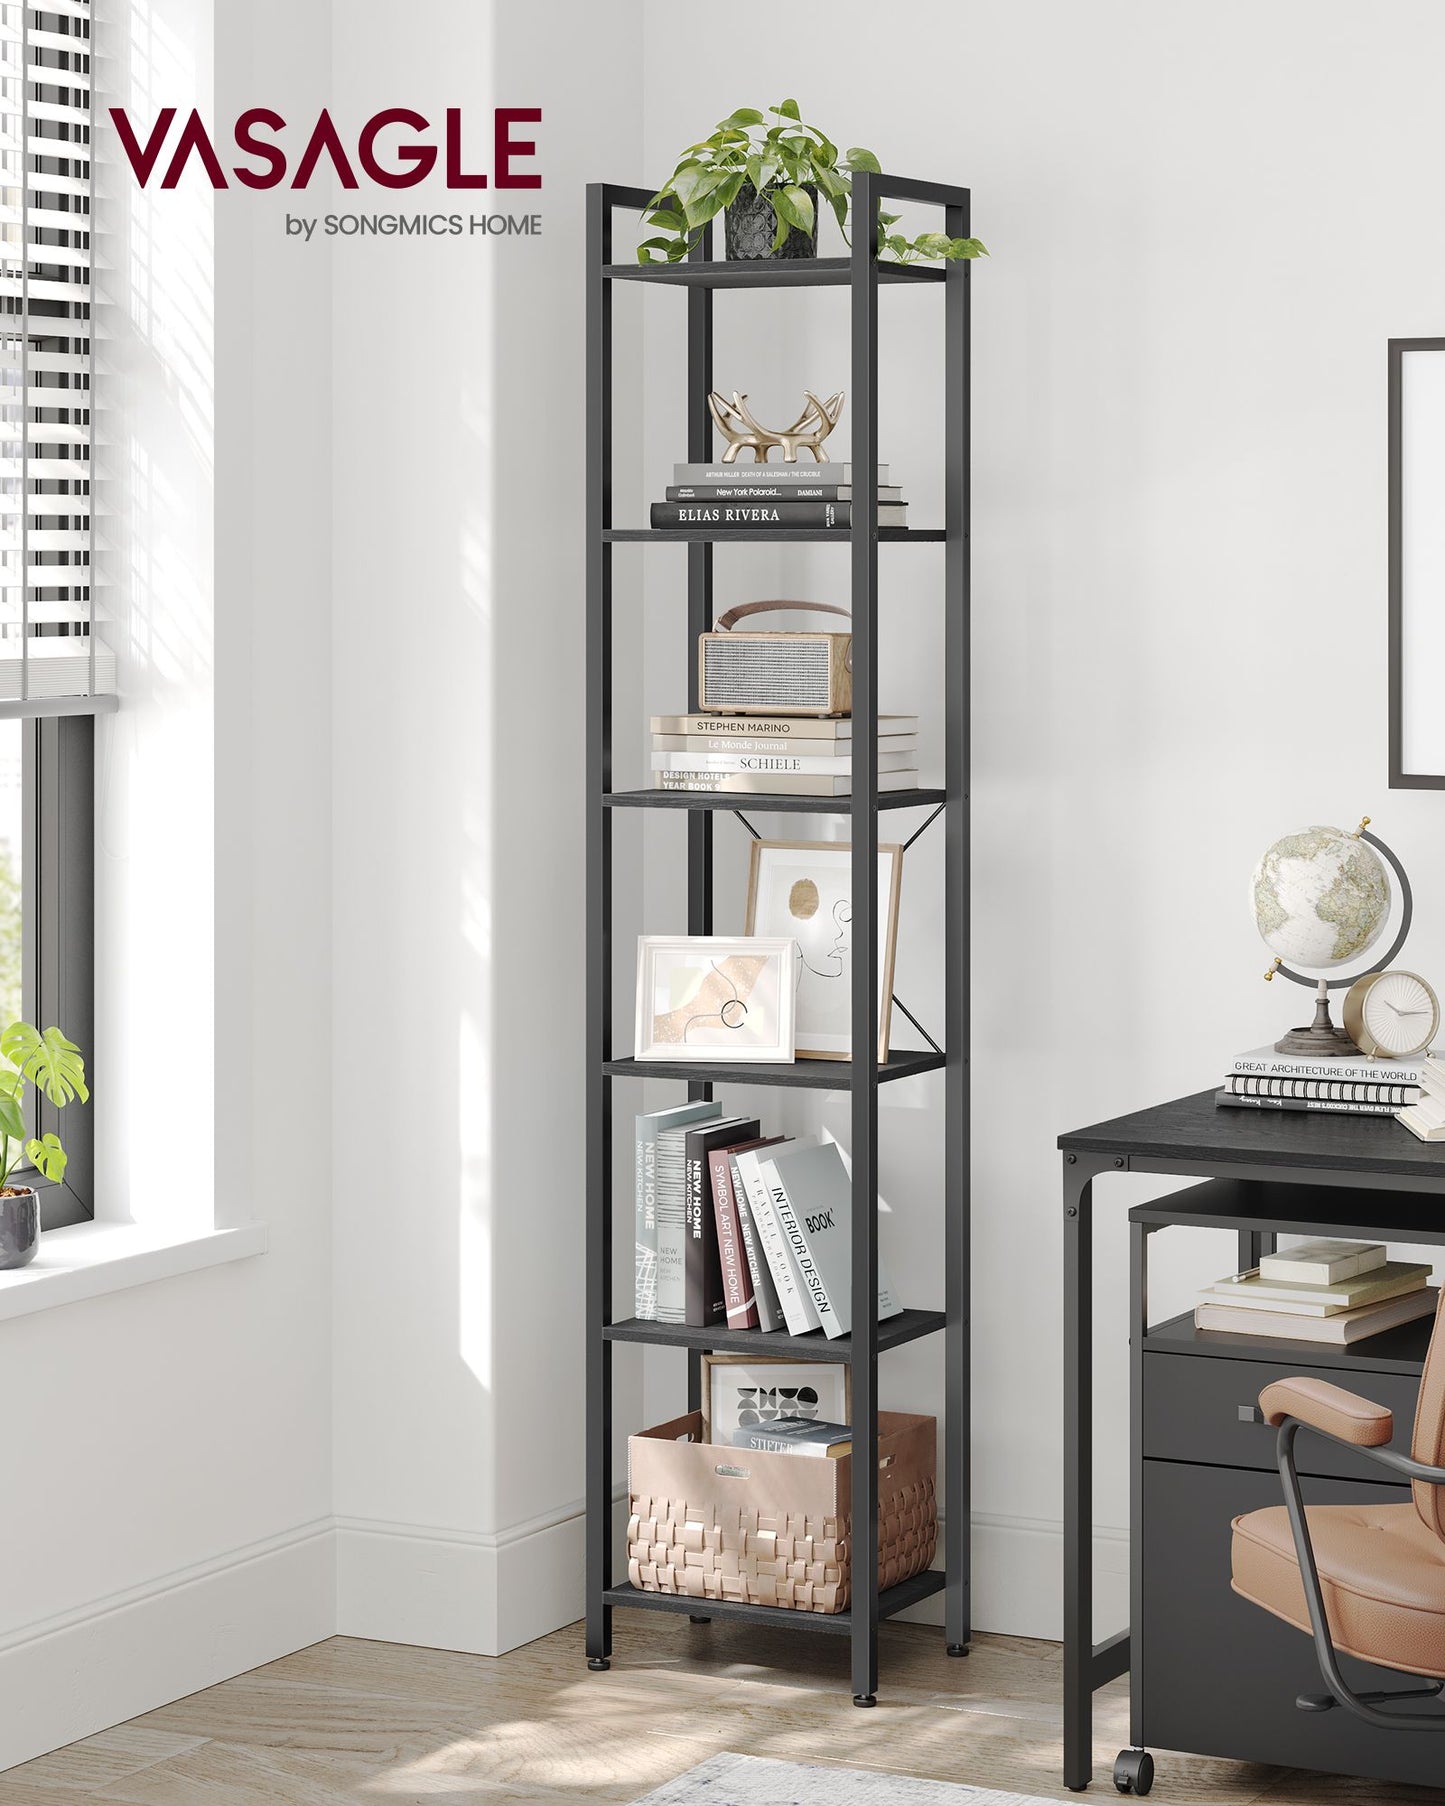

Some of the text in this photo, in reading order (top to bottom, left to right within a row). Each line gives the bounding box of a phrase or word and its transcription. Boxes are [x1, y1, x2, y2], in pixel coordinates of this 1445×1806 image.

[716, 488, 732, 496] New
[733, 488, 748, 496] York
[678, 509, 781, 521] ELIAS RIVERA
[697, 721, 790, 733] STEPHEN MARINO
[708, 740, 787, 751] Le Monde Journal
[740, 757, 801, 771] SCHIELE
[663, 771, 730, 781] DESIGN HOTELS
[663, 782, 686, 790] YEAR
[688, 783, 712, 791] BOOK
[1234, 1061, 1418, 1081] GREAT ARCHITECTURE OF THE WORLD
[645, 1142, 655, 1230] NEW HOME
[693, 1160, 702, 1239] NEW HOME
[731, 1166, 761, 1287] NEW HOME NEW KITCHEN
[714, 1165, 740, 1304] SYMBOL ART NEW HOME
[753, 1179, 794, 1294] TRAVEL BOOK
[660, 1247, 678, 1255] NEW
[771, 1187, 831, 1314] INTERIOR DESIGN
[660, 1257, 683, 1265] HOME
